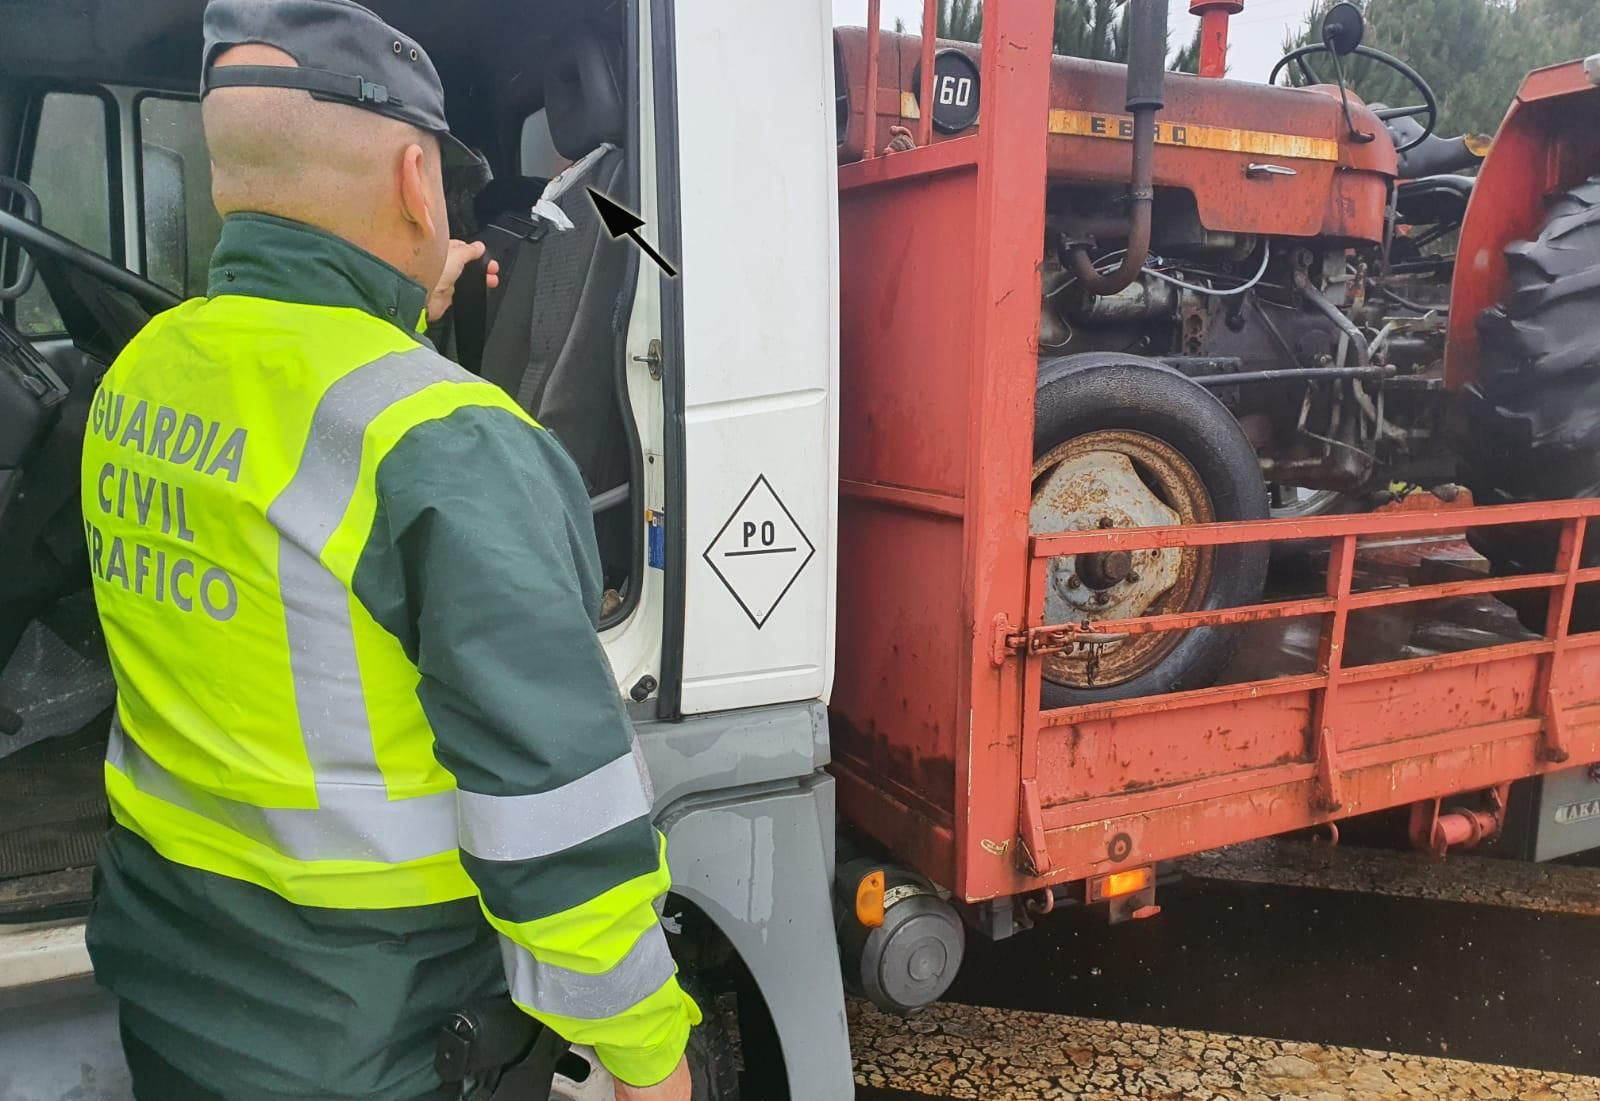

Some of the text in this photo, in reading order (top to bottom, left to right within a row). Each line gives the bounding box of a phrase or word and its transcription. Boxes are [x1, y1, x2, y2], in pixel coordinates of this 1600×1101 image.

[93, 388, 248, 482] GUARDIA
[98, 463, 194, 543] CIVIL
[743, 520, 775, 548] PO
